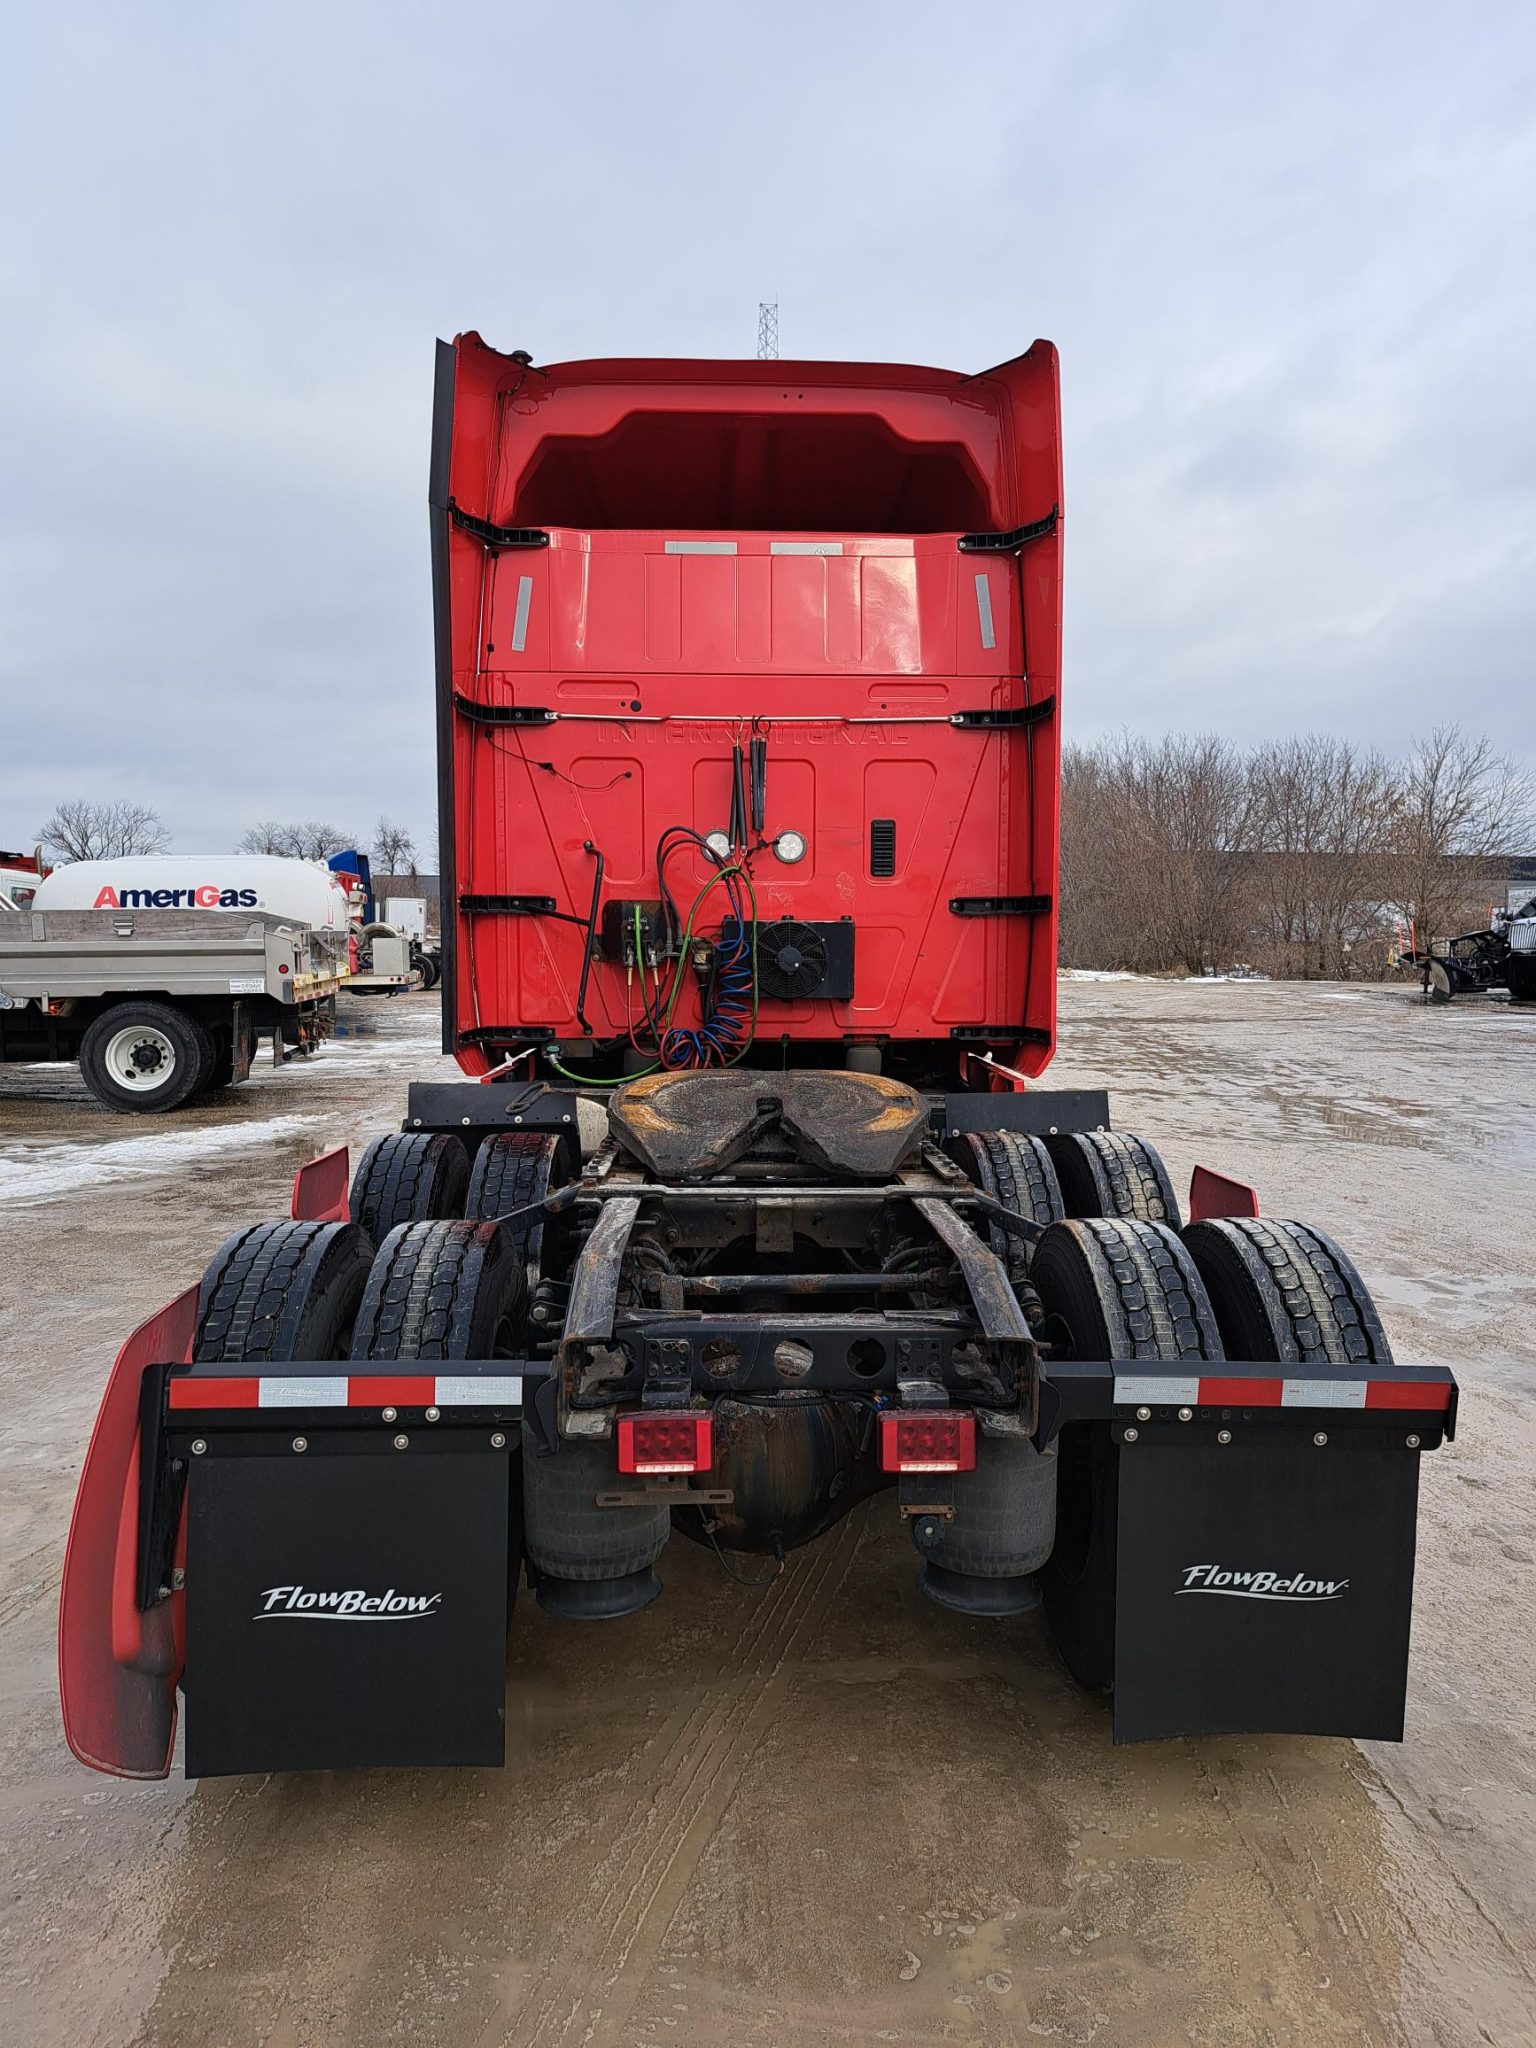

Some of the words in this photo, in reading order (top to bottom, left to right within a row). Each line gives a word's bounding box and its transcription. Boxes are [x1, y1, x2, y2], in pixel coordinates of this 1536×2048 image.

[93, 885, 258, 909] AmeriGas
[1182, 1564, 1350, 1595] FlowBelow
[260, 1585, 442, 1614] FlowBelow
